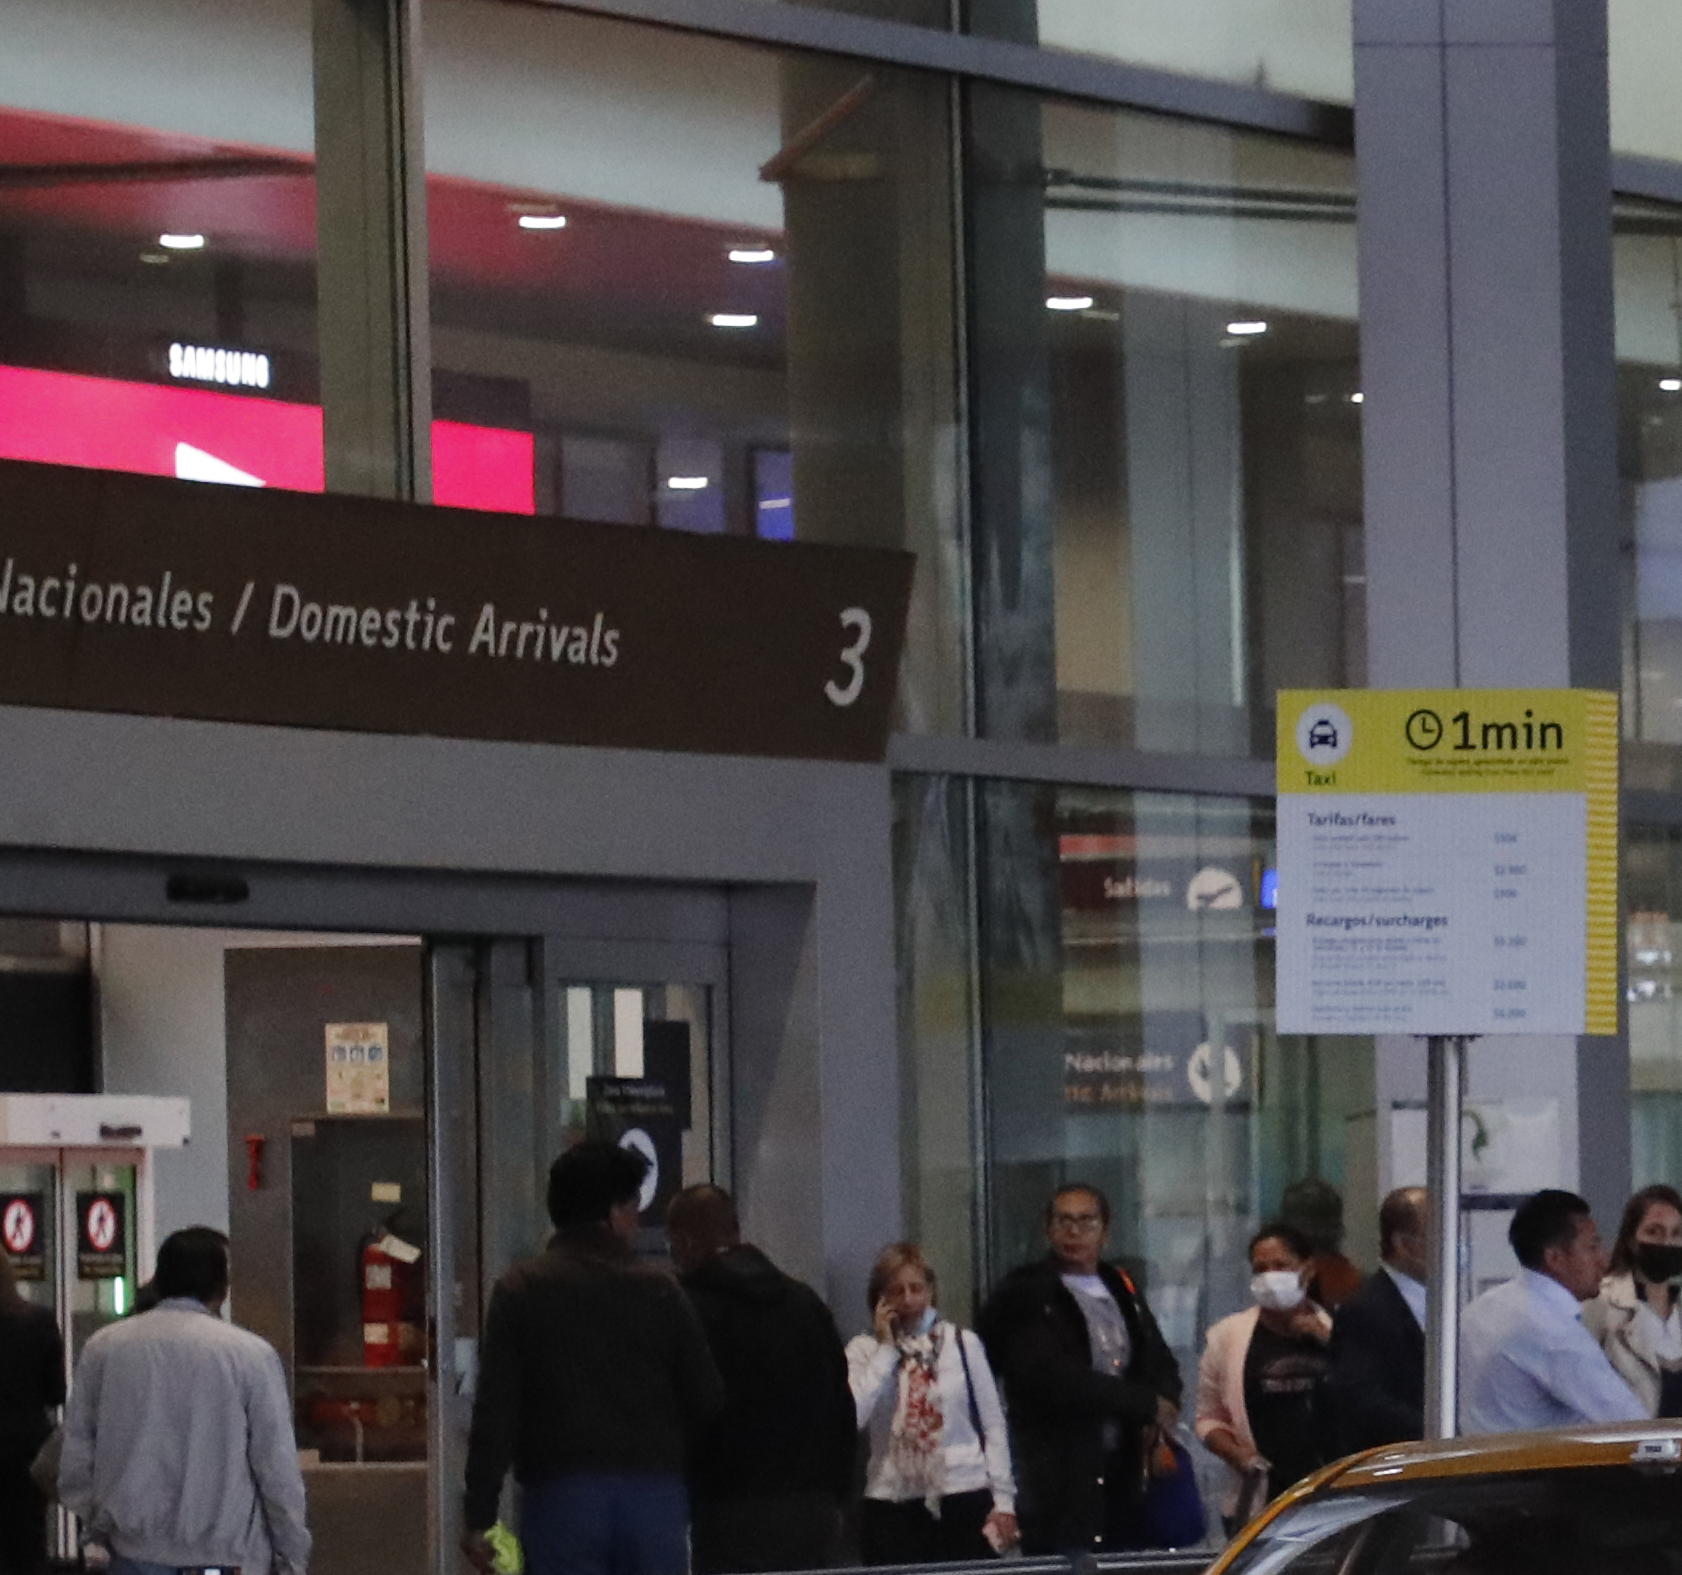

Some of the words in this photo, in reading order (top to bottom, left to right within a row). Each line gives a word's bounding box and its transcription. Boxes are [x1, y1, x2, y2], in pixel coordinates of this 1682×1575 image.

[169, 342, 270, 389] SAMSUNG
[268, 582, 456, 653] Domestic
[468, 602, 621, 668] Arrivals
[824, 606, 872, 706] 3
[1452, 708, 1564, 751] 1min
[1305, 770, 1338, 787] Taxi
